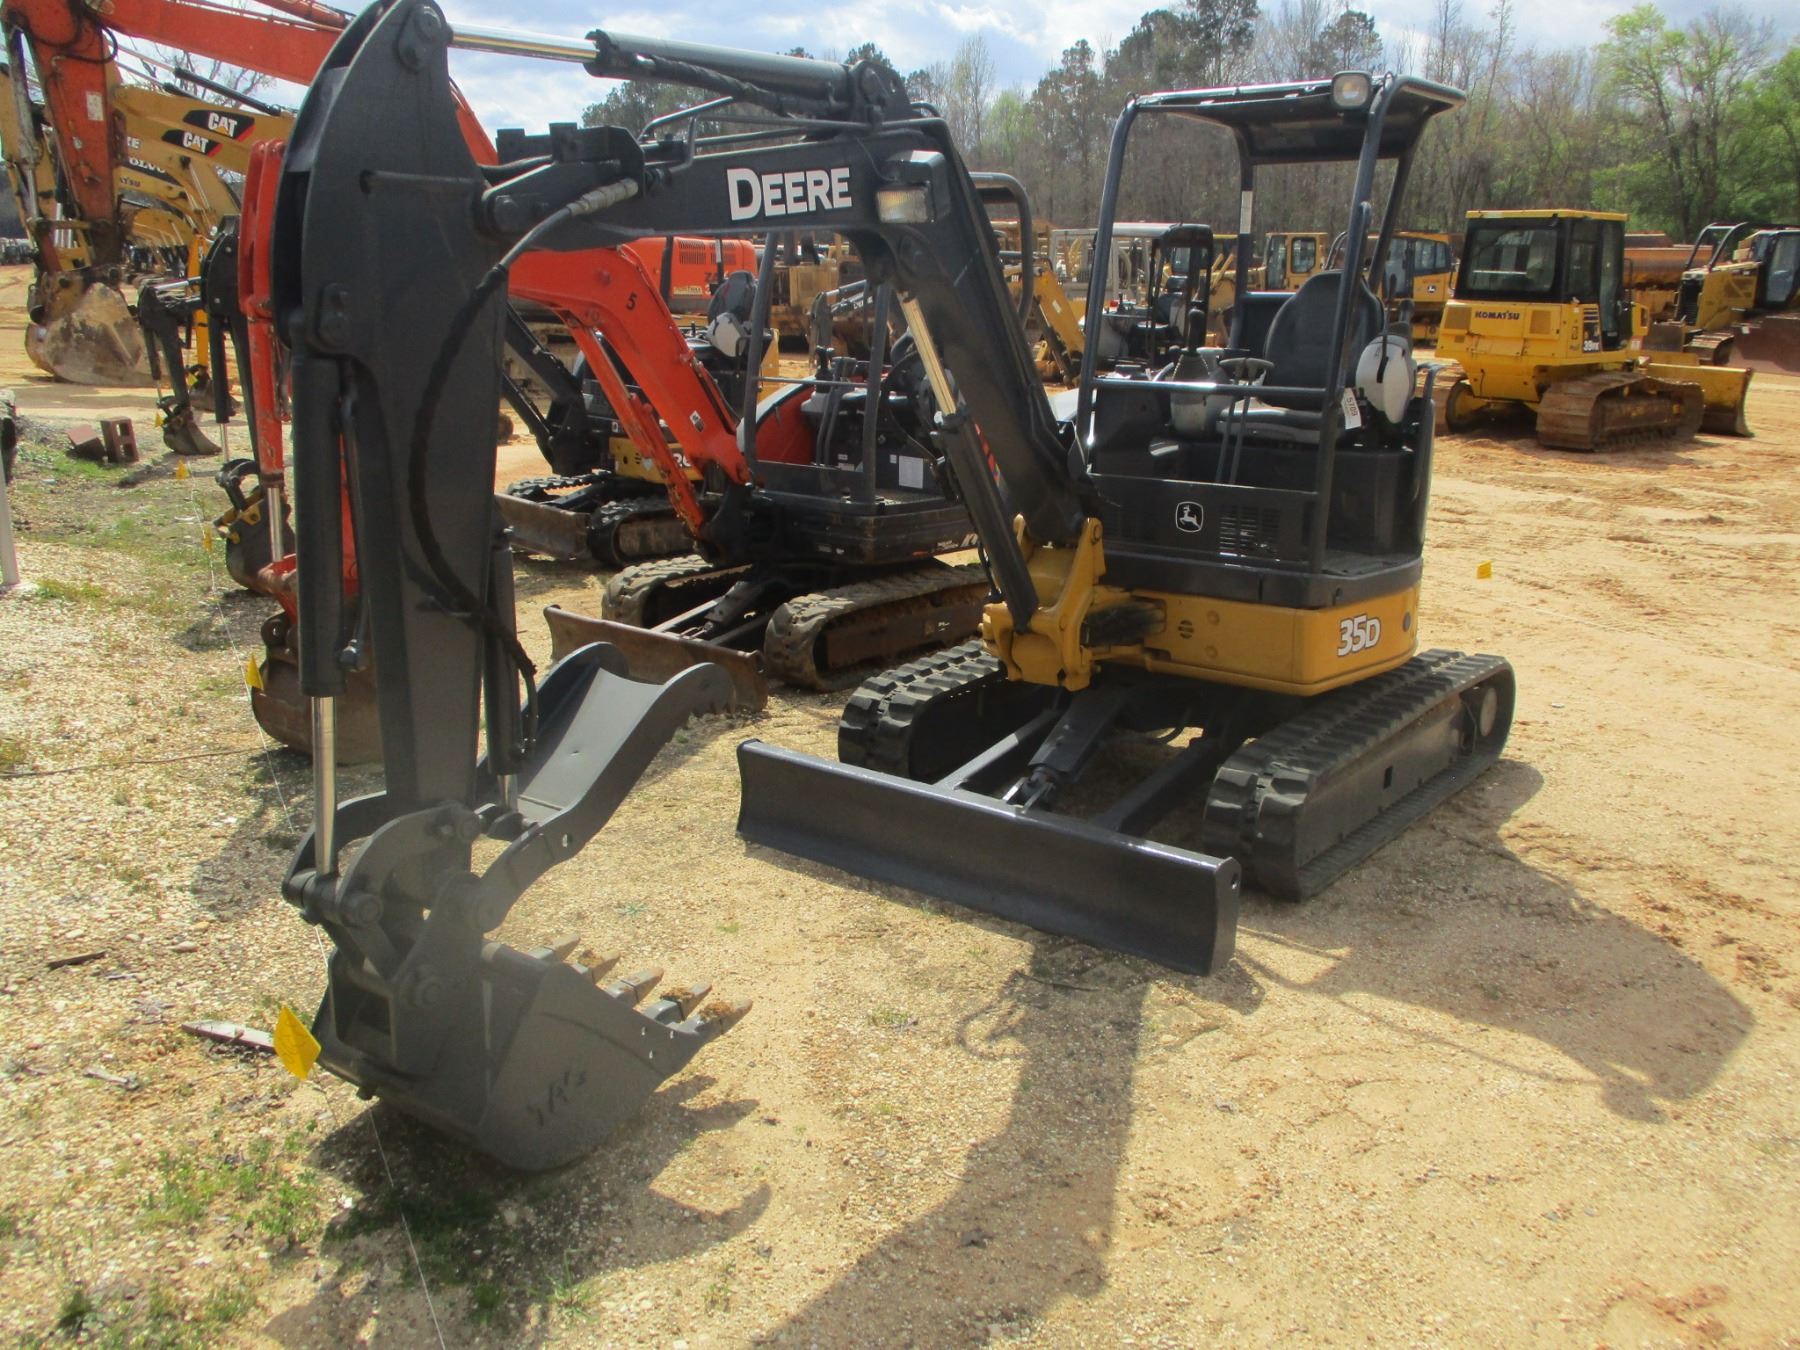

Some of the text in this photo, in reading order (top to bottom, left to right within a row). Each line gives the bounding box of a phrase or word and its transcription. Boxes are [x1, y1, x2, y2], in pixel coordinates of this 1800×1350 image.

[207, 112, 238, 138] CAT
[183, 132, 209, 154] CAT
[727, 167, 853, 221] DEERE
[1475, 310, 1520, 321] KOMATSU
[1337, 614, 1381, 657] 35D
